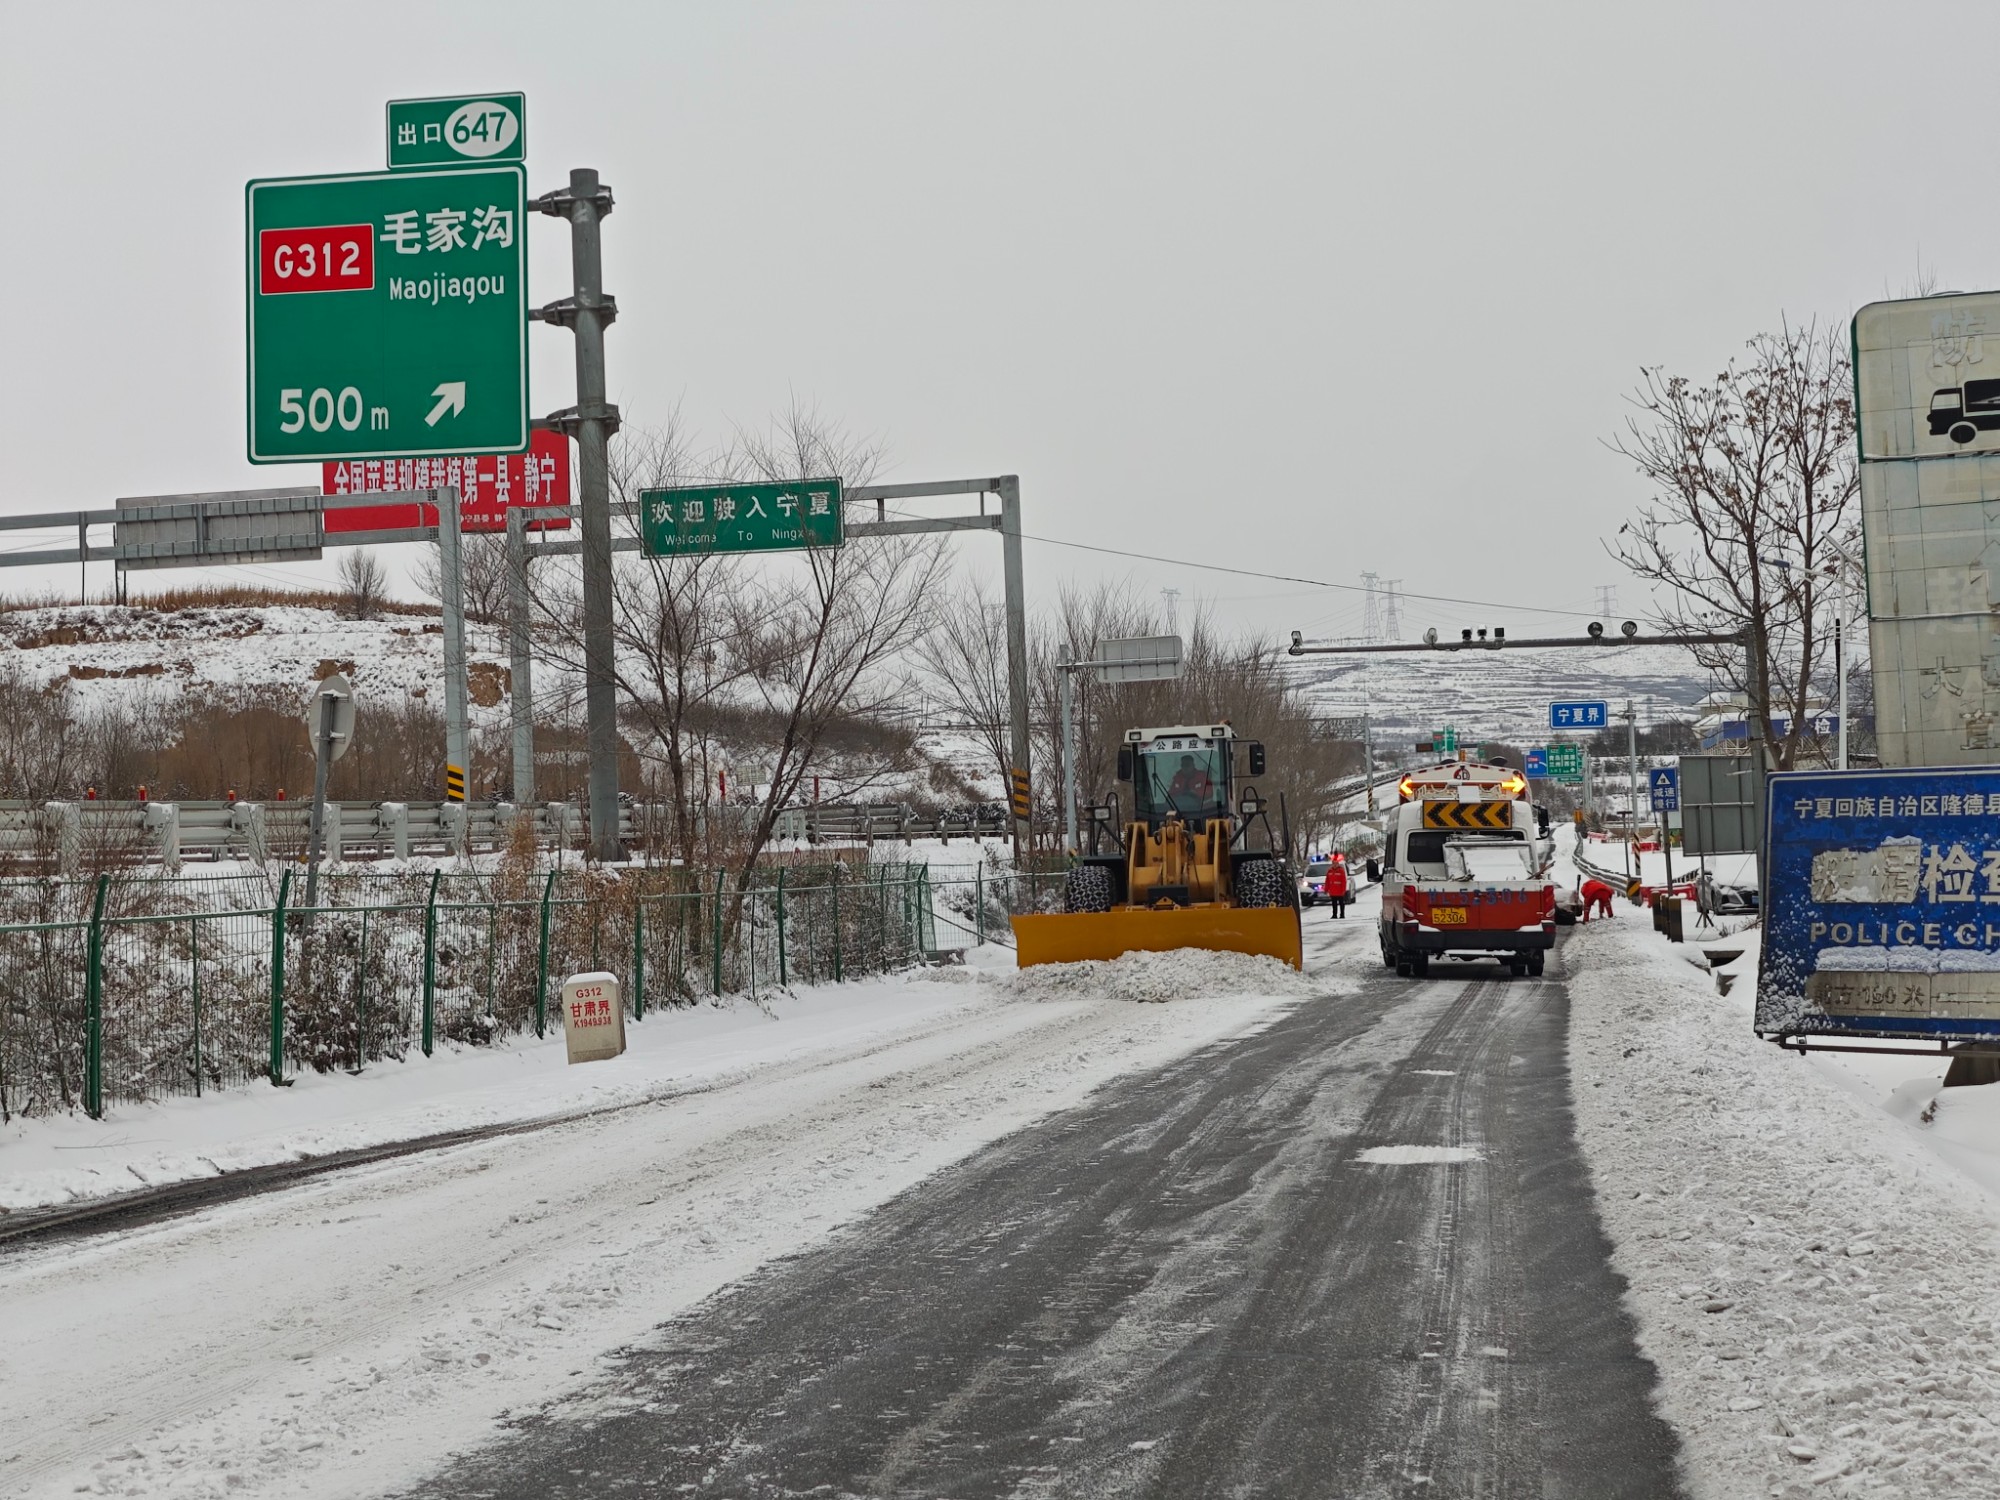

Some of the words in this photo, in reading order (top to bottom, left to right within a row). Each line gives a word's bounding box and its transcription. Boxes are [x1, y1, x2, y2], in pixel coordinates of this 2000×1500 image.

[397, 122, 442, 146] 出口
[452, 110, 507, 144] 647
[379, 204, 514, 255] 毛家沟
[273, 241, 361, 279] G312
[389, 271, 505, 306] Maojiagou
[651, 491, 832, 525] 欢迎驶入宁夏
[737, 530, 754, 541] To
[1557, 707, 1600, 724] 宁夏界
[1793, 792, 2000, 820] 宁夏回族自治区隆德县
[1433, 913, 1465, 923] 52306
[1809, 922, 1942, 945] POLICE
[576, 987, 602, 998] G312
[570, 1000, 610, 1018] 甘肃界
